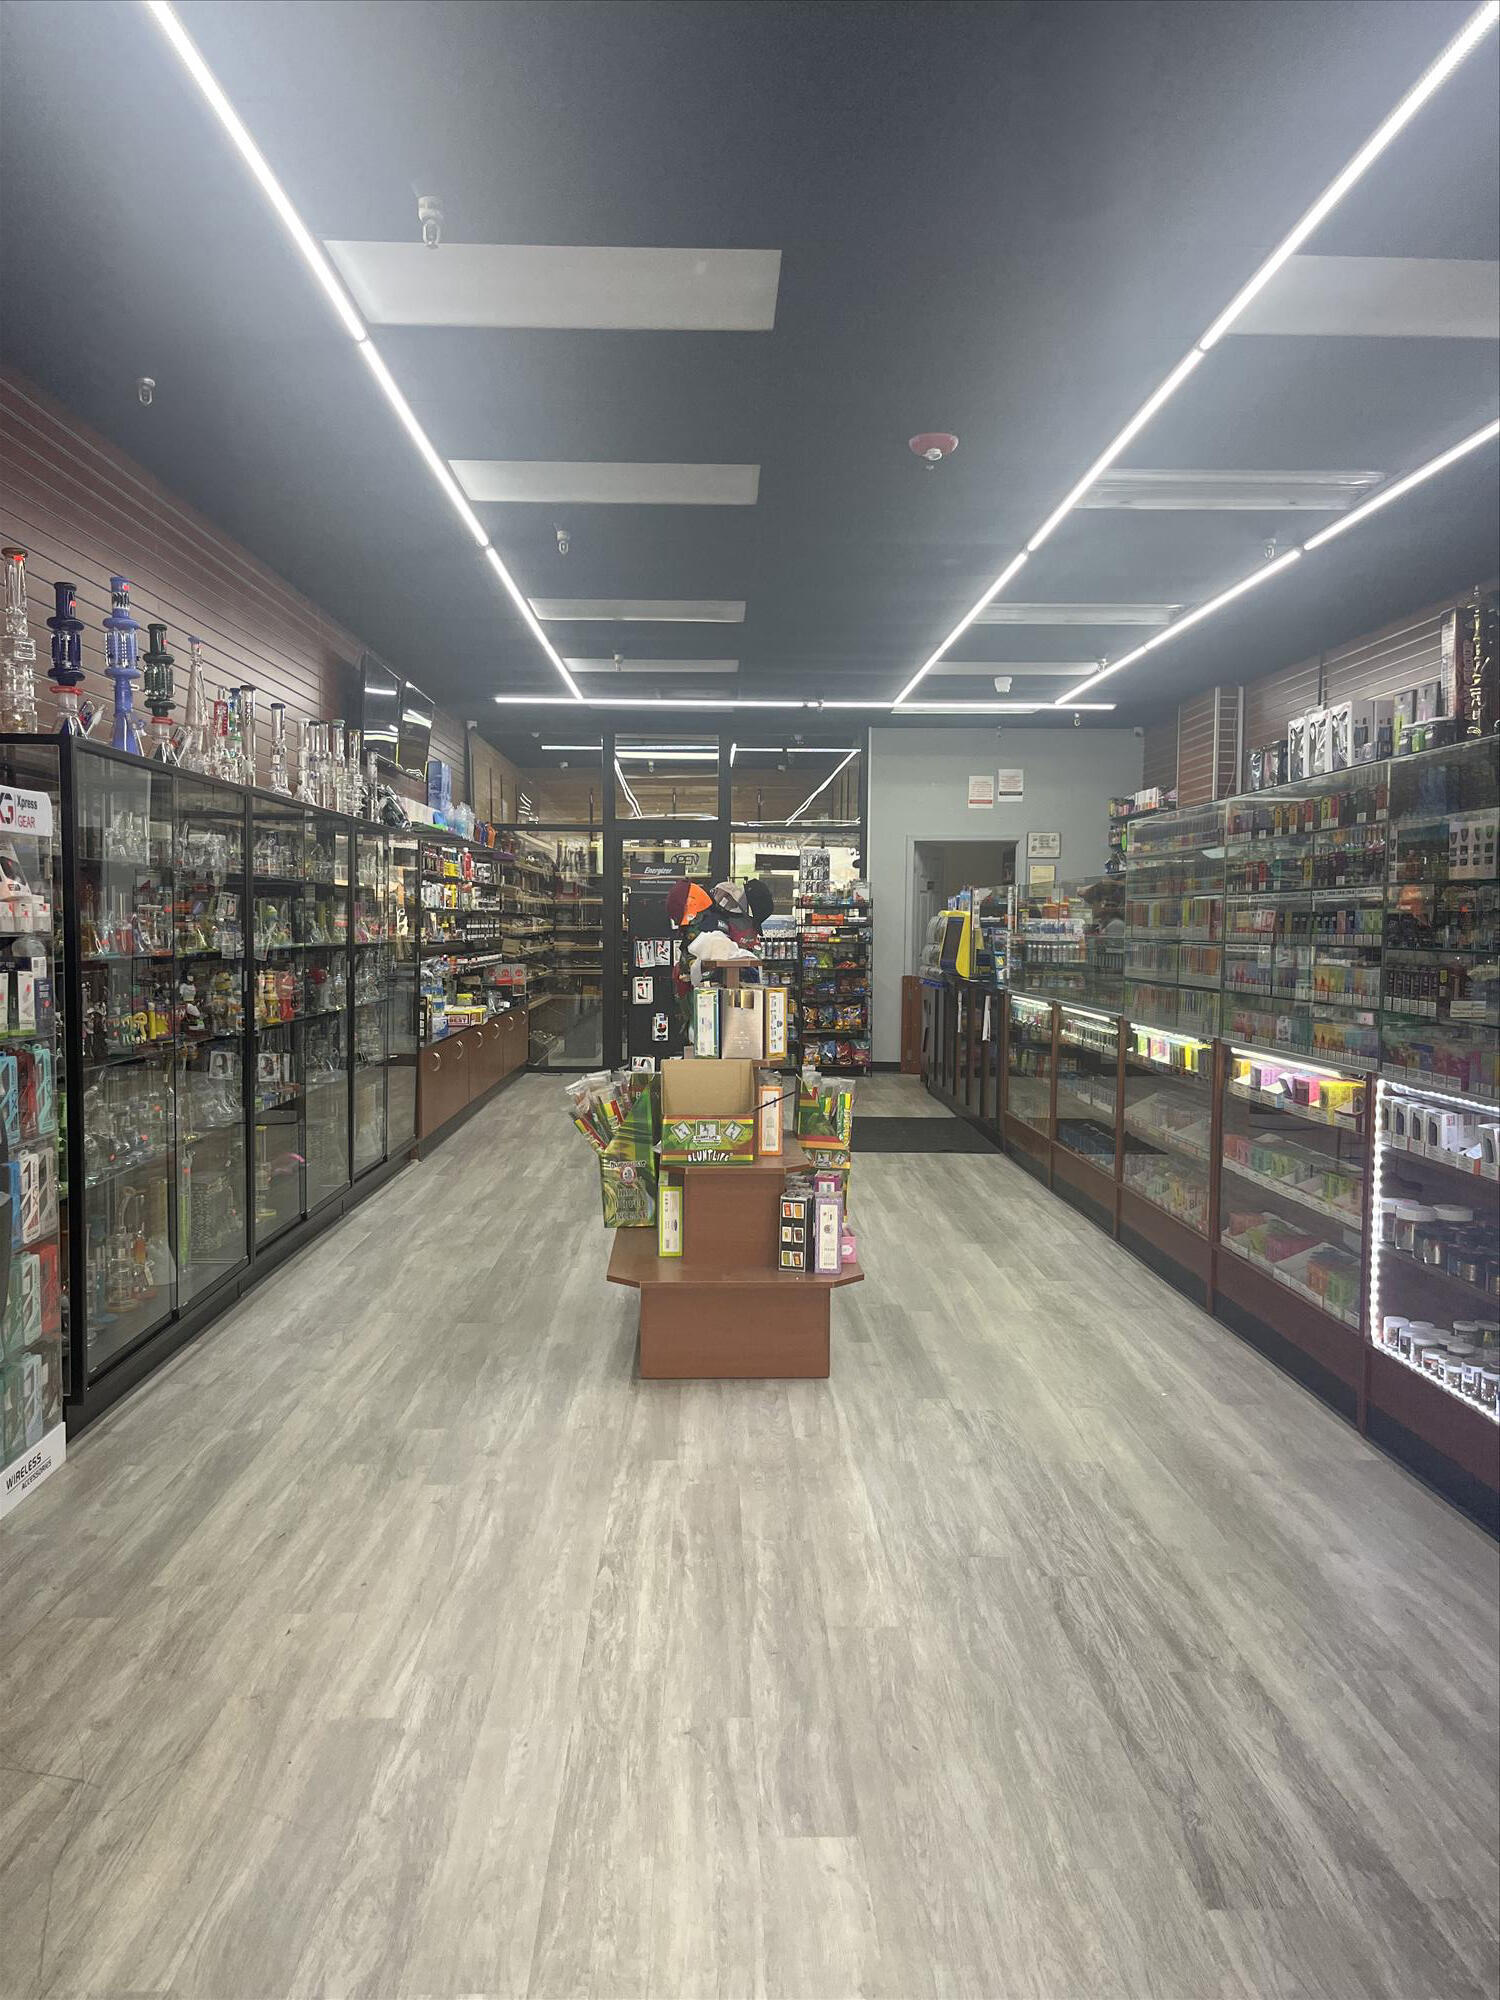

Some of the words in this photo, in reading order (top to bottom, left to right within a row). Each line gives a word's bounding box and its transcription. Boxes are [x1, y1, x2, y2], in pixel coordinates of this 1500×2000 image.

[17, 794, 38, 810] Xpress
[18, 815, 36, 828] GEAR
[644, 867, 673, 875] Energizer
[6, 1452, 42, 1489] WIRELESS
